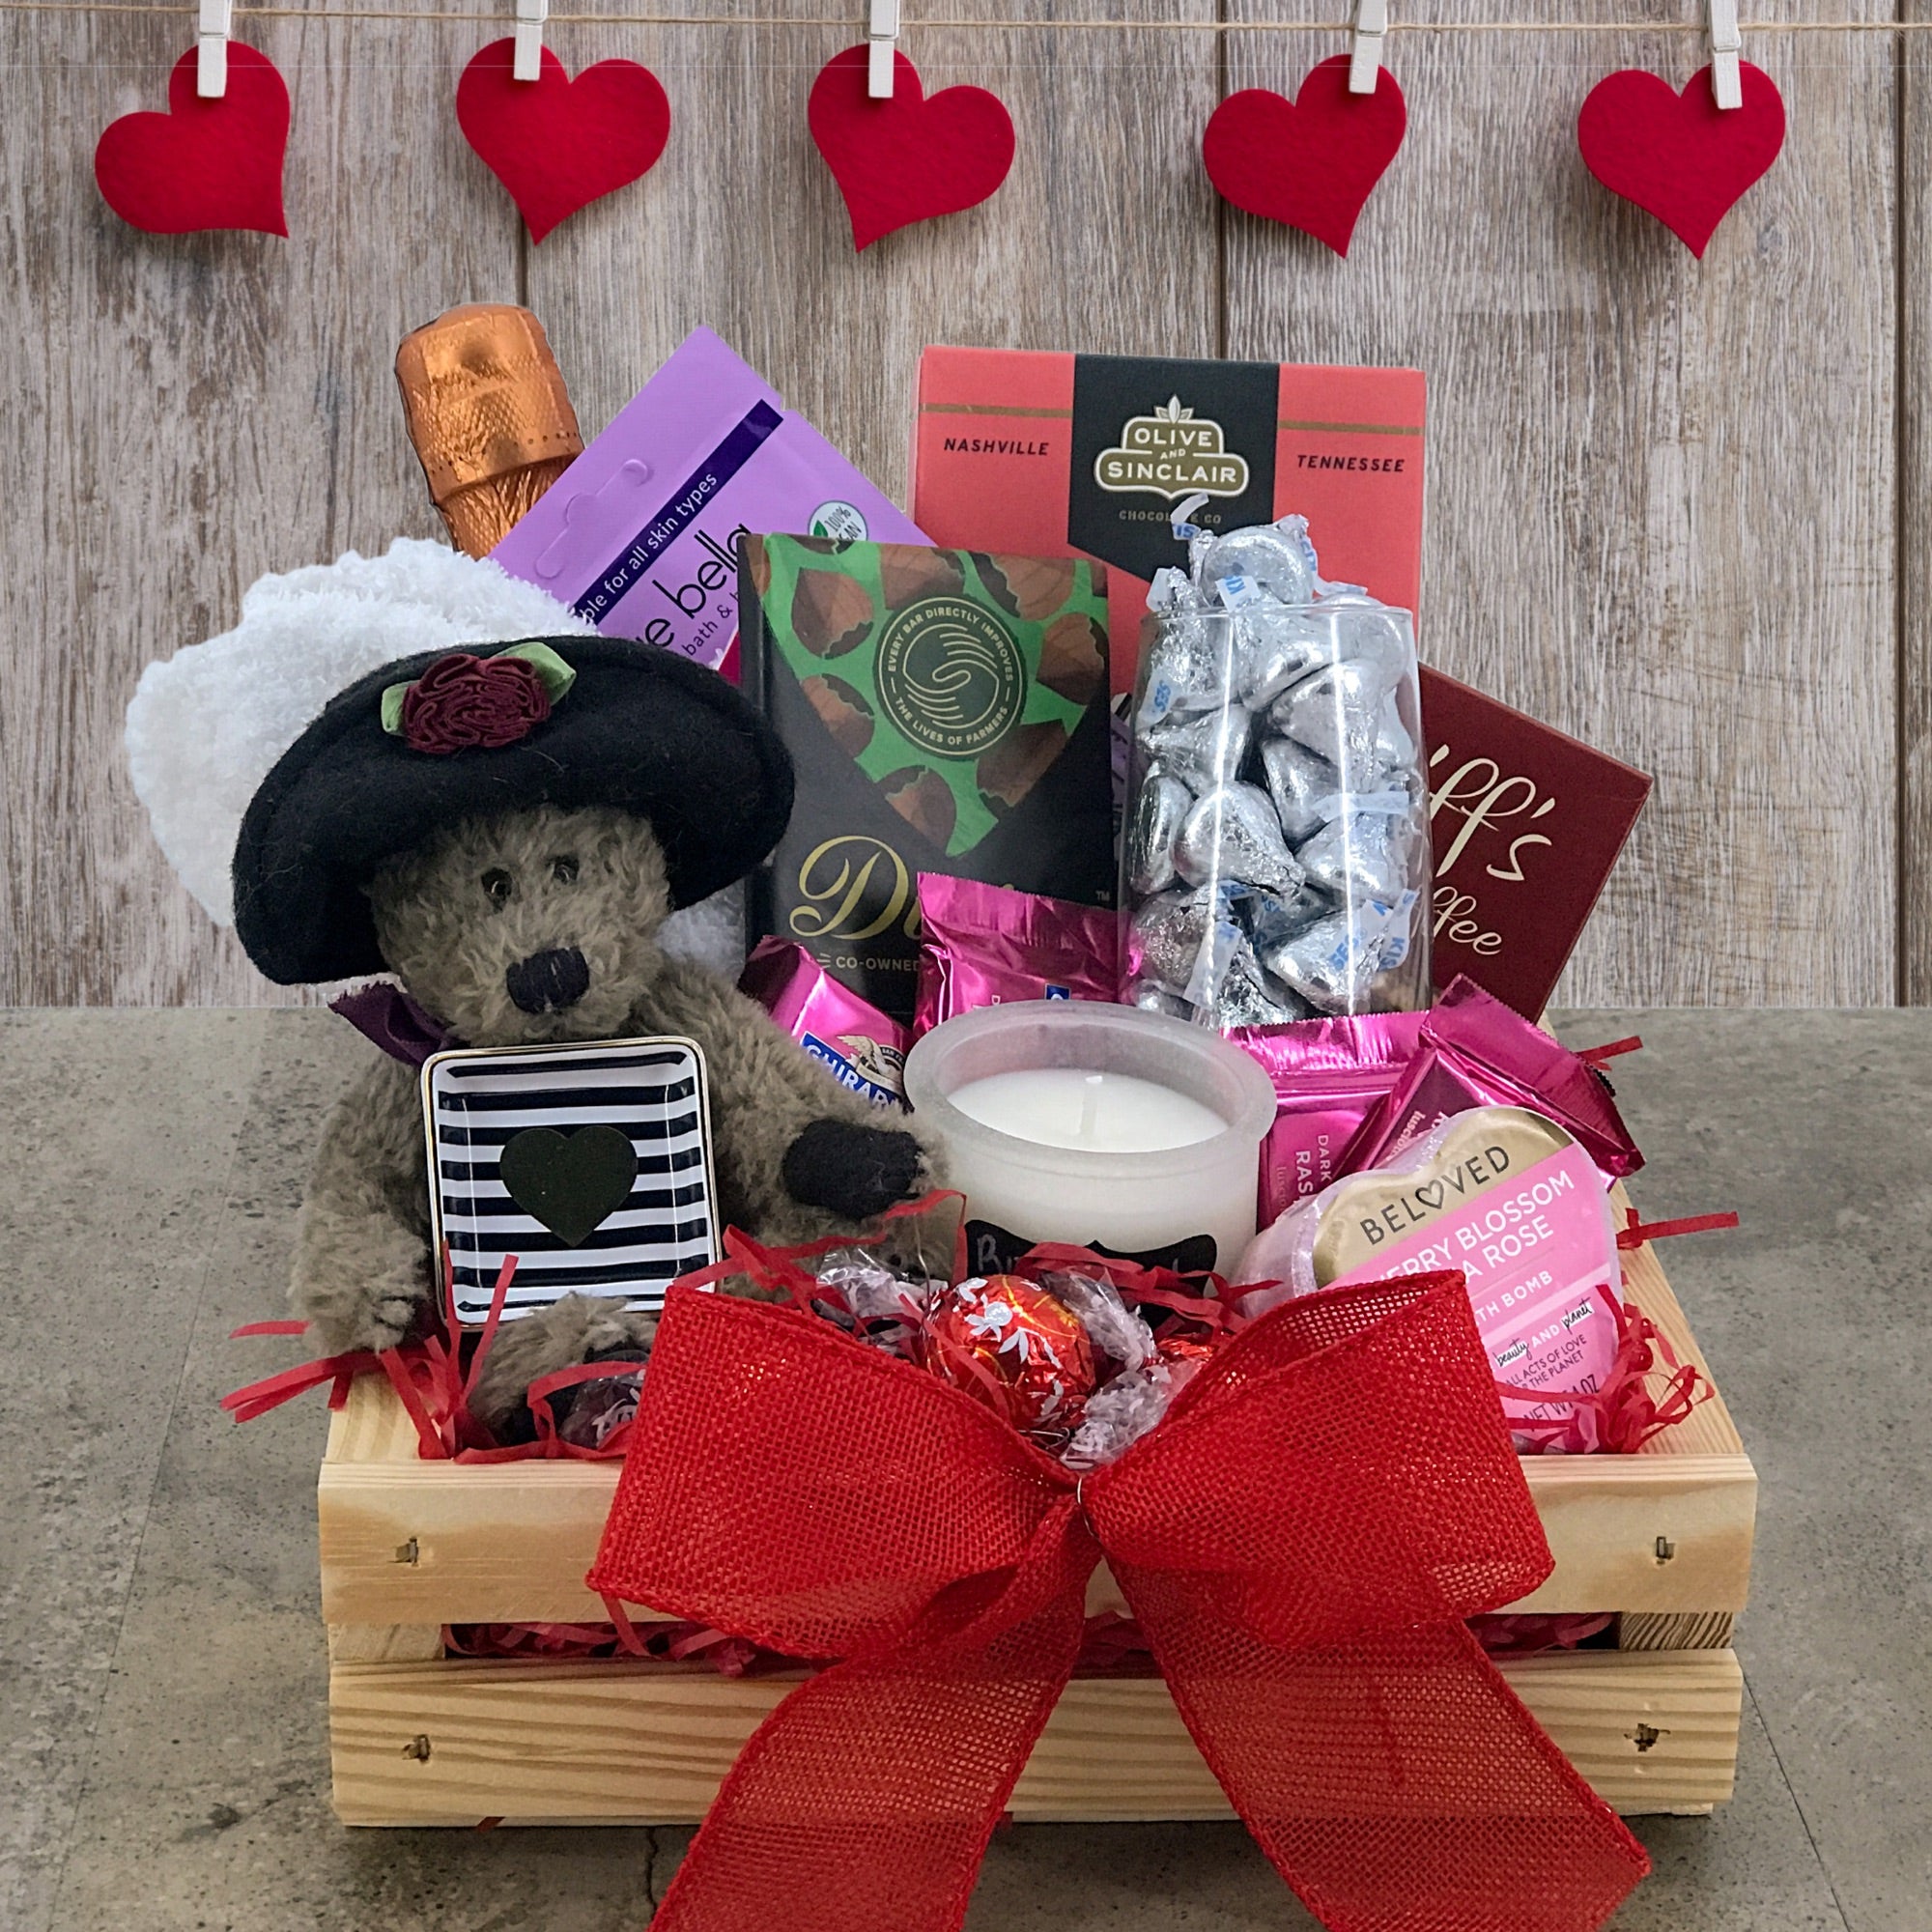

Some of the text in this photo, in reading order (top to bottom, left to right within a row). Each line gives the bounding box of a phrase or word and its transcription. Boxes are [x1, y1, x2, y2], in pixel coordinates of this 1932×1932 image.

[944, 438, 1049, 456] NASHVILLE
[1134, 427, 1212, 447] OLIVE
[1160, 448, 1185, 461] AND
[1107, 461, 1236, 483] SINCLAIR
[1297, 454, 1406, 473] TENNESSEE
[604, 568, 629, 595] for
[628, 545, 649, 570] all
[647, 523, 679, 550] skin
[675, 473, 718, 517] types
[1119, 510, 1222, 525] CHOCOLE CO
[682, 604, 733, 657] bath &
[888, 607, 1014, 682] EVERY BAR DIRECTLY IMPROVES
[895, 696, 1009, 746] THE LIVES OF FARMERS
[1430, 744, 1556, 881] ff's
[1317, 1134, 1333, 1182] DARK
[1455, 1170, 1575, 1251] BLOSSOM
[1482, 1214, 1554, 1268] ROSE
[1501, 1270, 1553, 1308] BOMB
[1492, 1296, 1593, 1368] beauty AND planet
[1522, 1358, 1548, 1378] ACTS
[1547, 1349, 1561, 1363] OF
[1561, 1334, 1587, 1354] LOVE
[1529, 1350, 1584, 1389] THE PLANET
